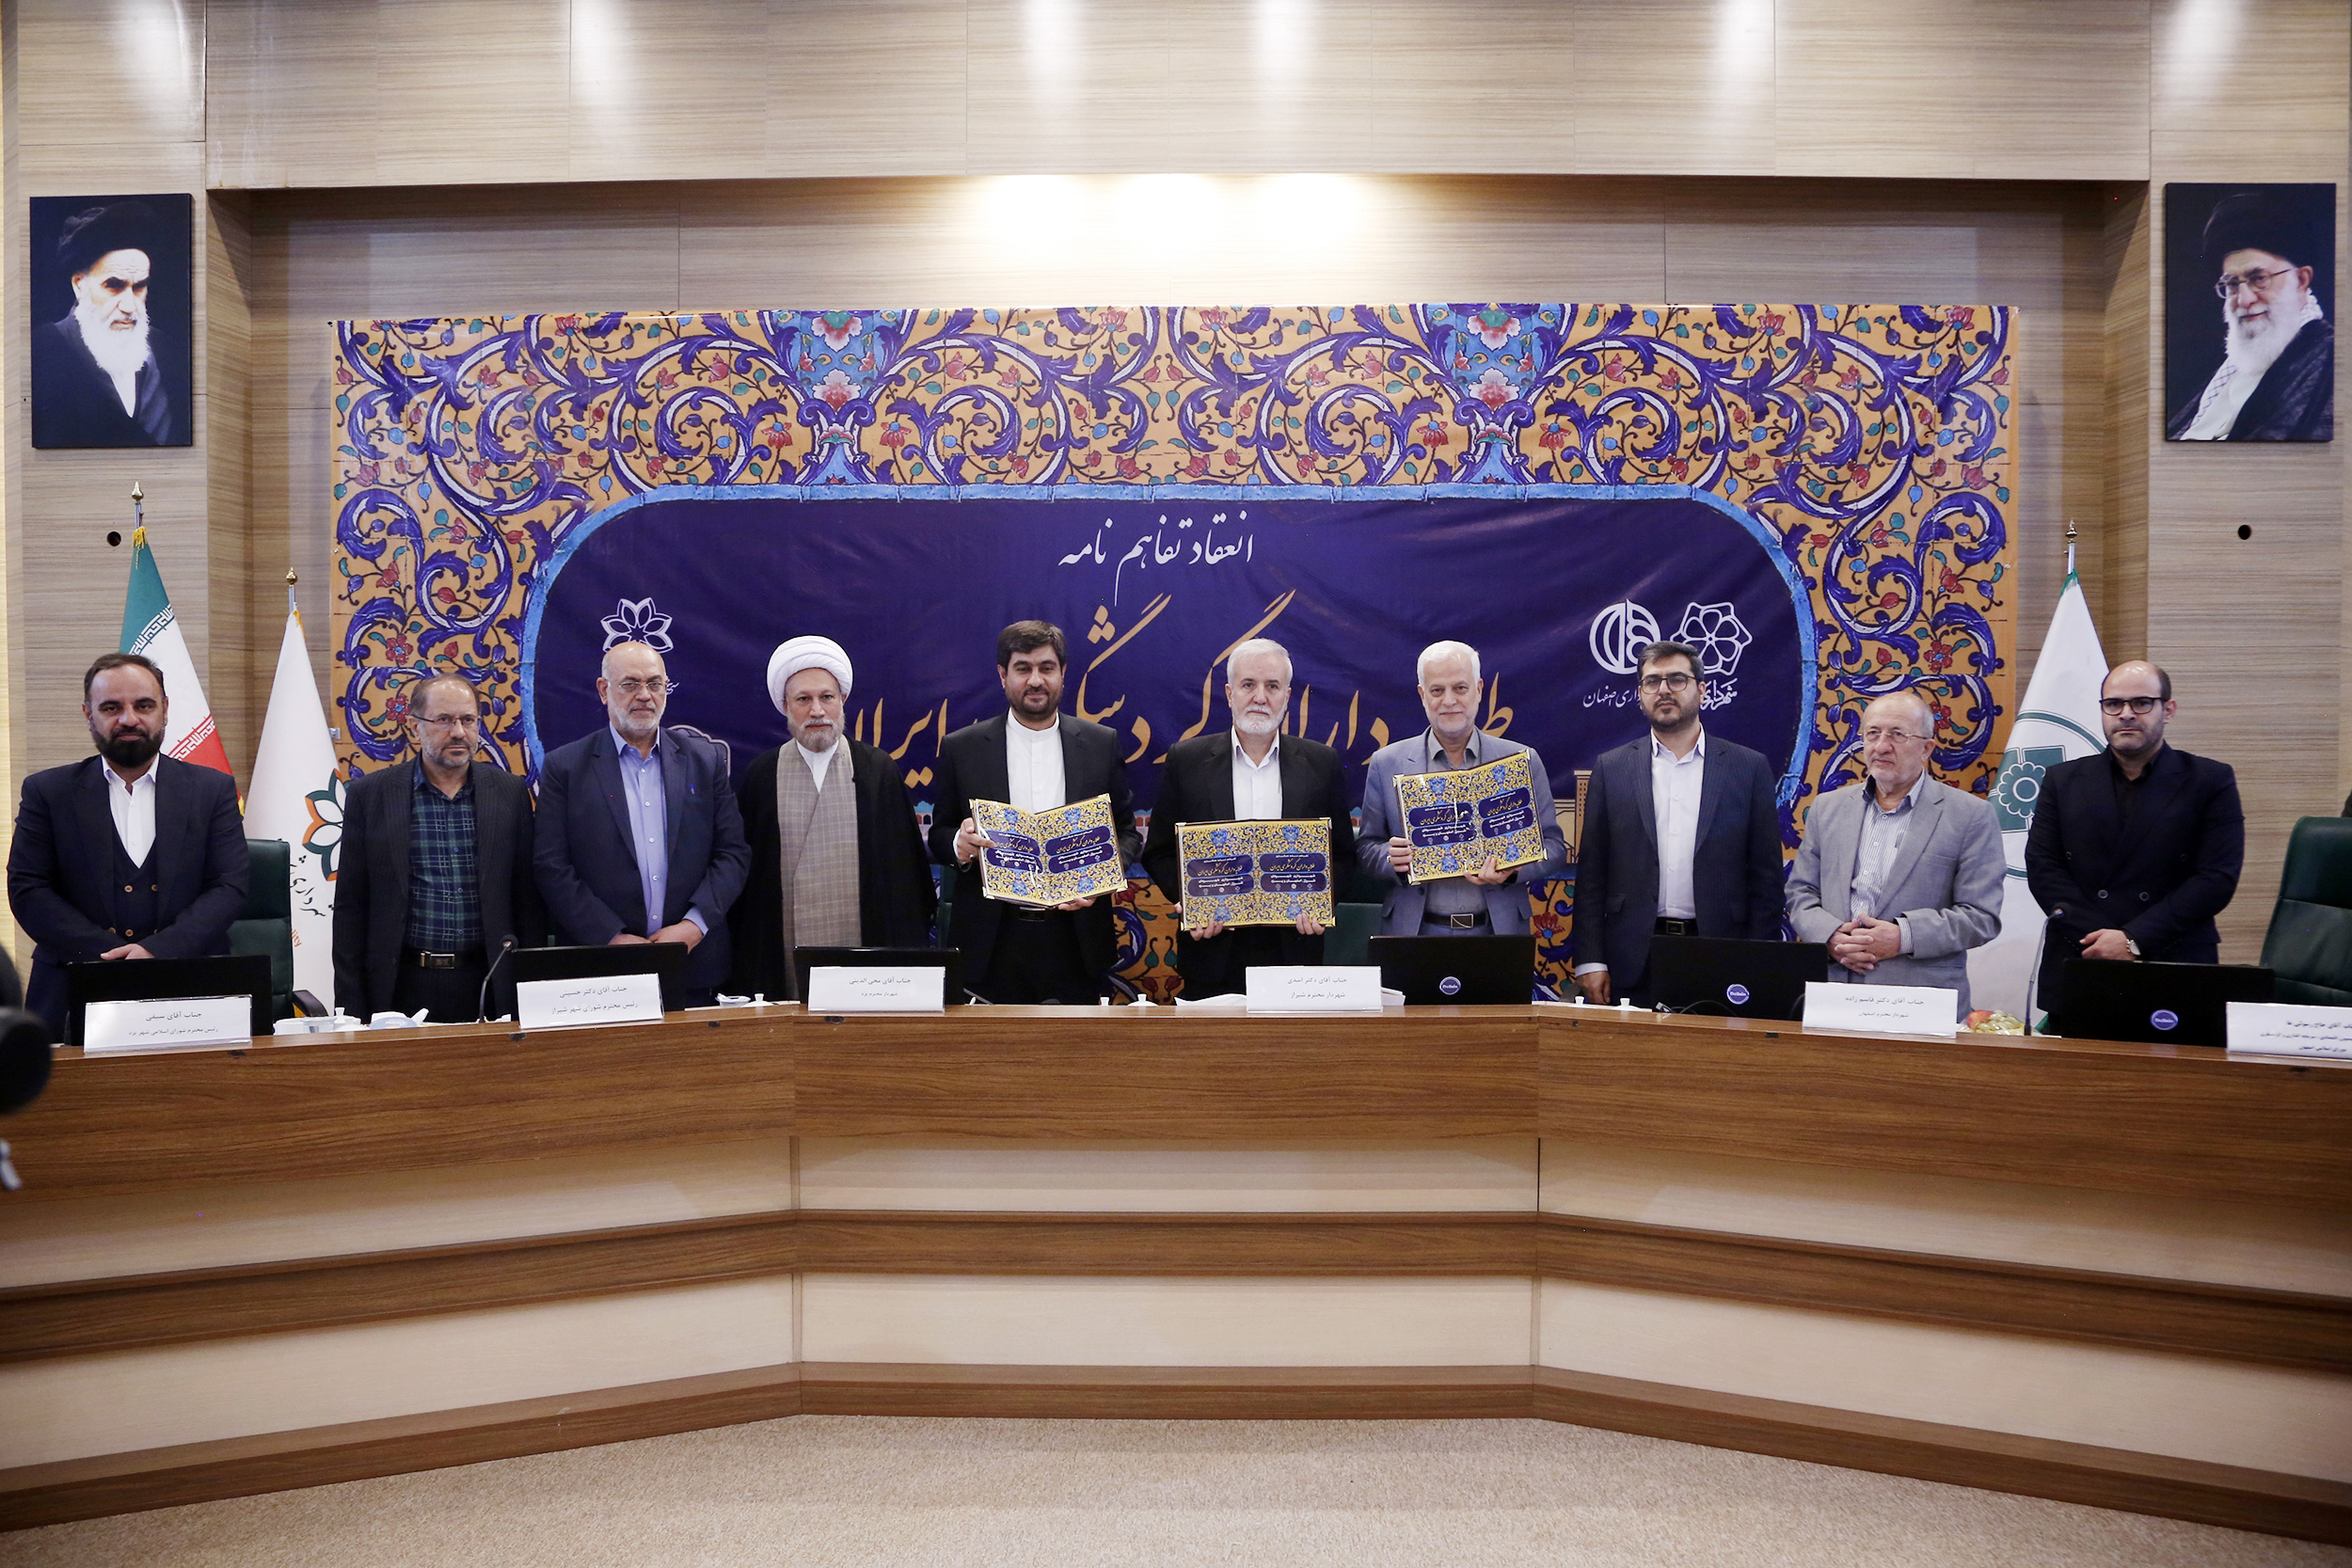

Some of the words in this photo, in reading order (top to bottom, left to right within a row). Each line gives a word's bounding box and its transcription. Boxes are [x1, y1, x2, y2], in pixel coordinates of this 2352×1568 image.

[1057, 517, 1114, 566] نامه
[1113, 514, 1194, 607] تفاهم
[1188, 510, 1254, 565] انعقاد
